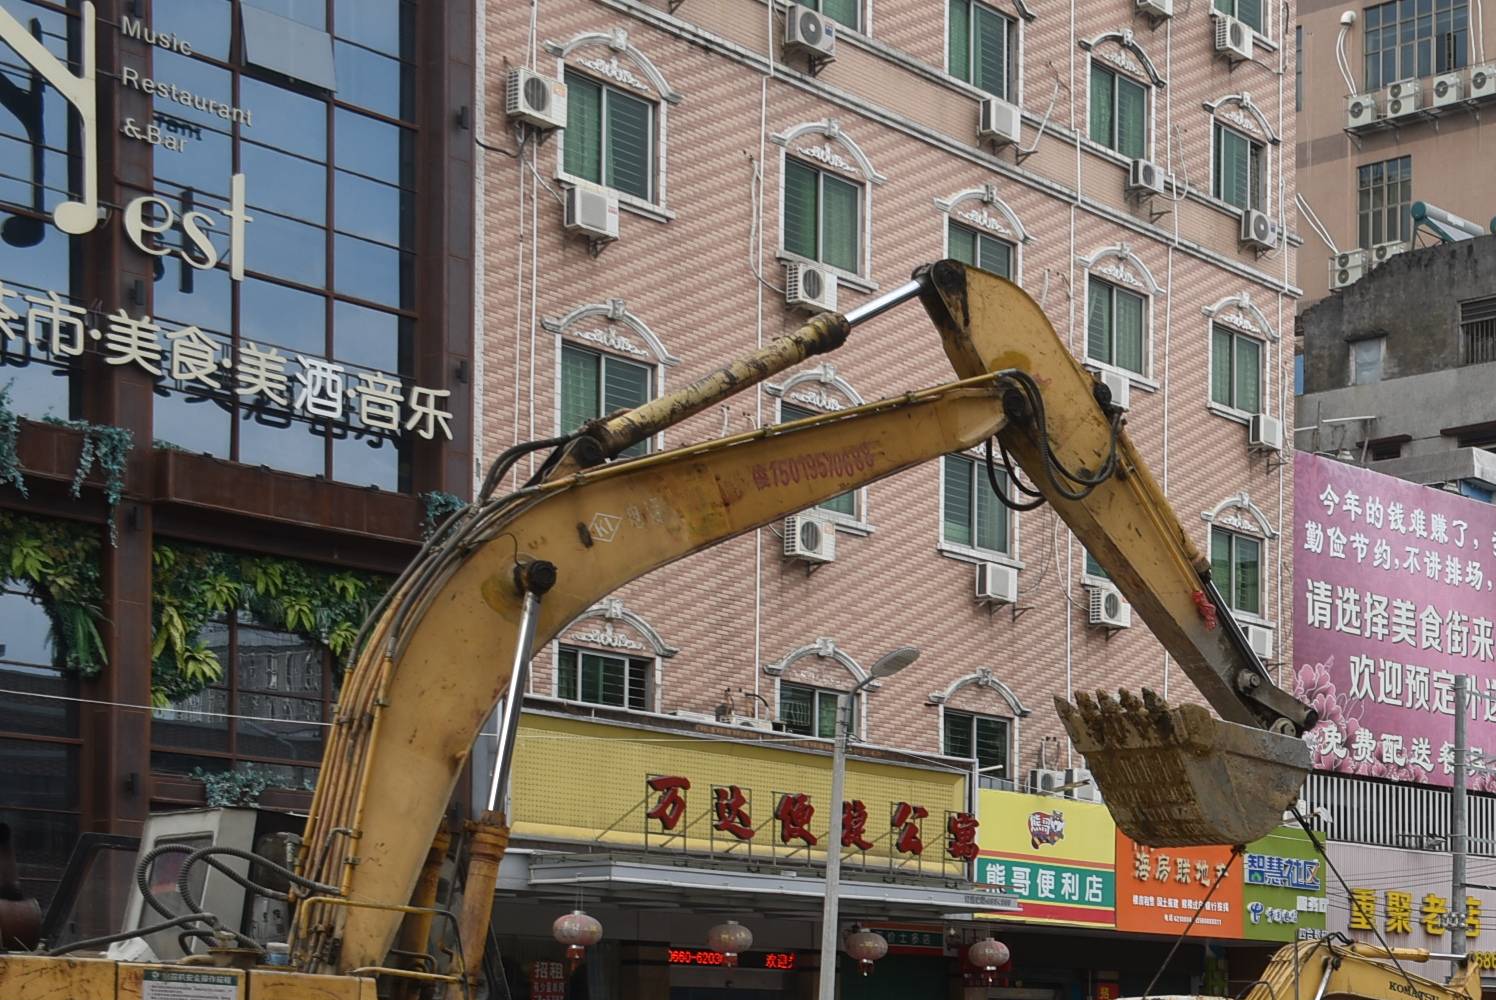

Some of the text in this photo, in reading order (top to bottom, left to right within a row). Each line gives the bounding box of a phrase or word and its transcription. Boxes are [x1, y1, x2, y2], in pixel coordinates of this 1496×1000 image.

[121, 15, 193, 56] Music
[122, 66, 254, 127] Restaurant
[123, 117, 188, 153] &Bar
[646, 774, 981, 861] 万达便捷公寓
[985, 862, 1104, 902] 熊哥便利店
[1246, 853, 1320, 890] 智慧社区
[1349, 888, 1482, 938] 重聚老店
[534, 961, 563, 979] 招租
